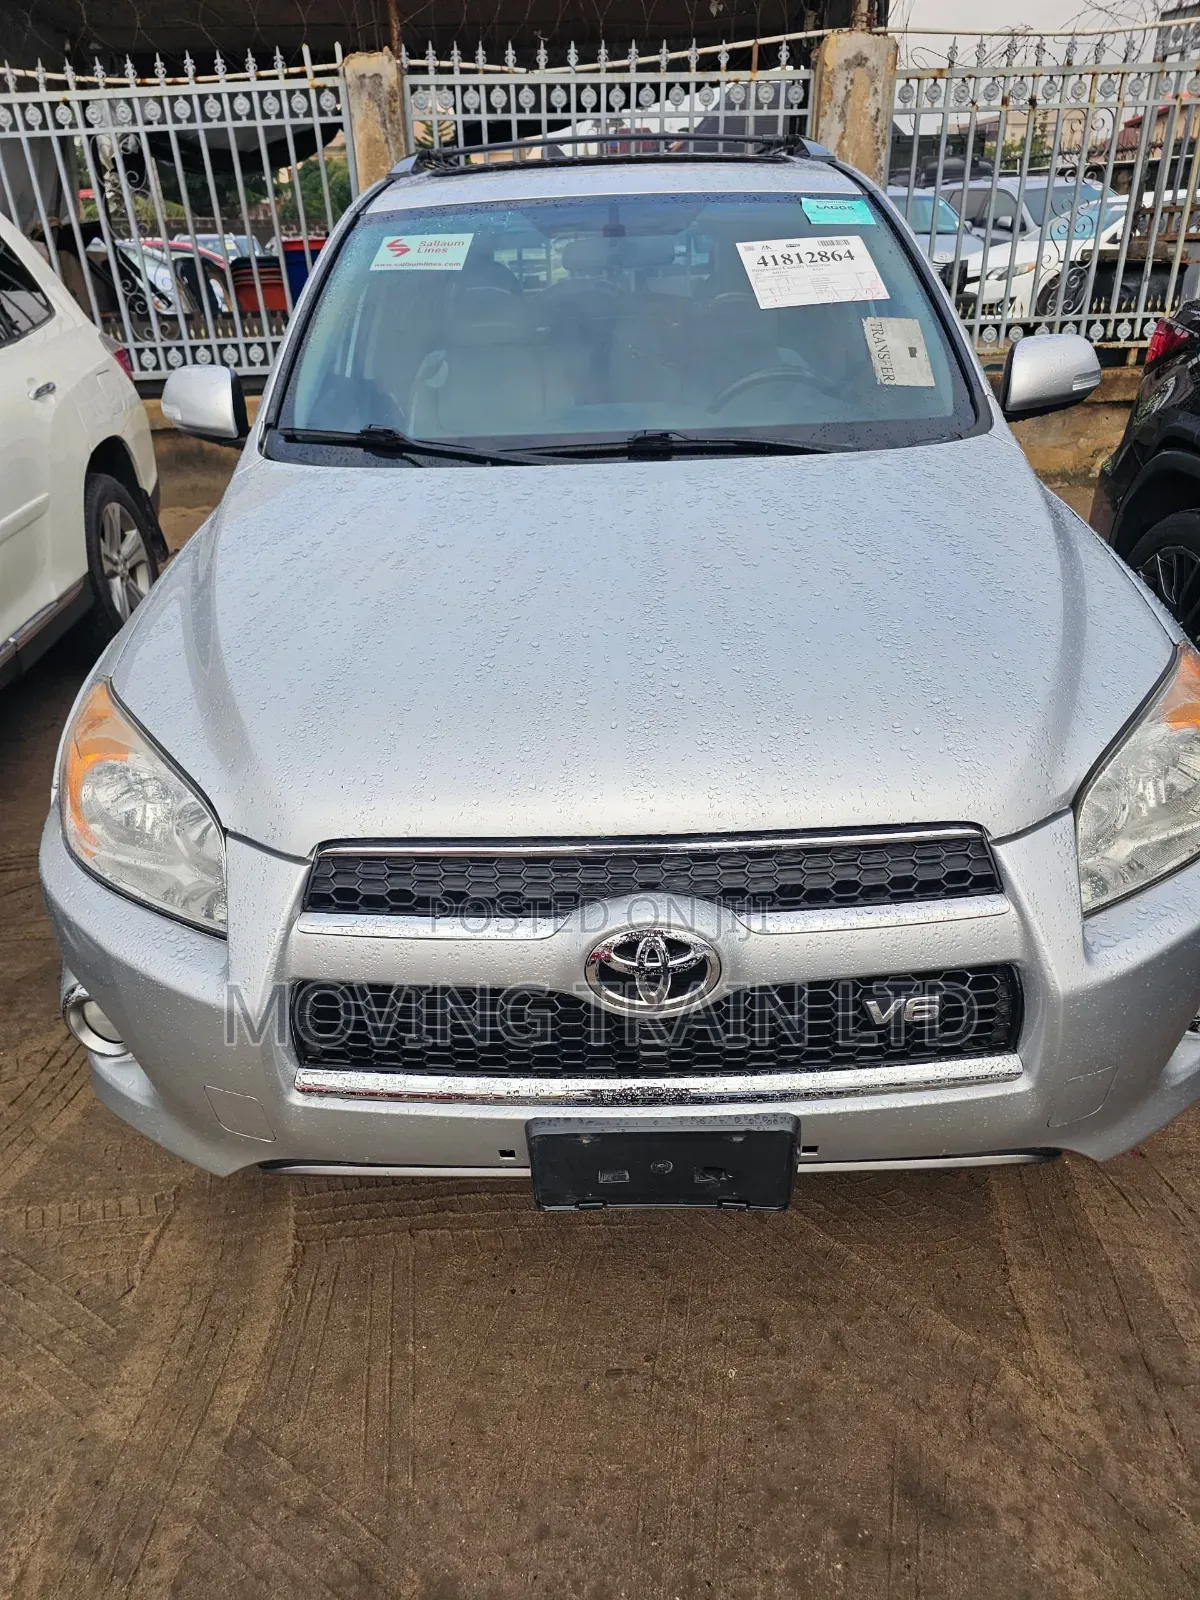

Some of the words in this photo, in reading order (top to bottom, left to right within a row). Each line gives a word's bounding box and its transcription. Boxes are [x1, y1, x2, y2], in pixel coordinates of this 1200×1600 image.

[418, 239, 465, 247] Sallaum
[756, 249, 855, 267] 41812864
[861, 995, 943, 1026] V6
